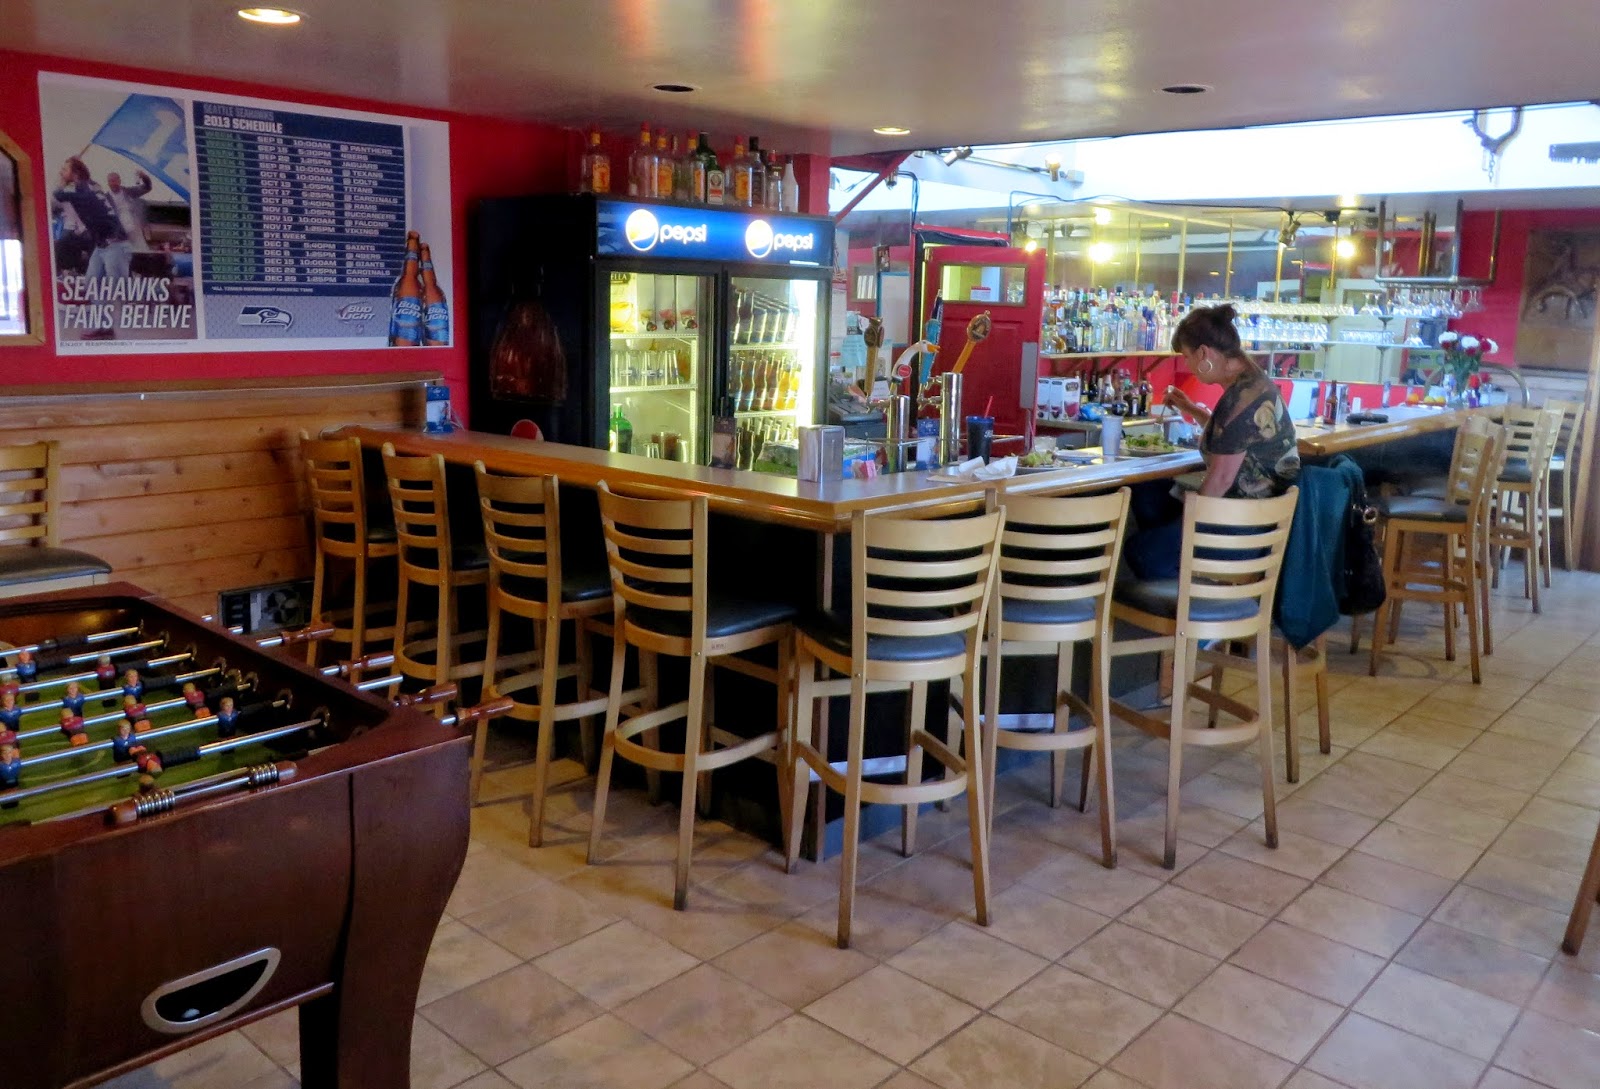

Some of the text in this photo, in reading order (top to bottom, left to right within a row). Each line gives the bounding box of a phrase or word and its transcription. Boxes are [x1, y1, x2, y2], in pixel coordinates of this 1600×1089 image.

[203, 114, 283, 134] 2013 SCHEDULE
[350, 146, 393, 155] PANTHERS
[352, 170, 383, 179] TEXANS
[353, 178, 378, 187] COLTS
[343, 186, 373, 194] TITANS
[354, 195, 398, 204] CARDINALS
[354, 203, 377, 211] RAMS
[354, 220, 389, 228] FALCONS
[263, 231, 280, 239] BYE
[282, 232, 307, 240] WEEK
[345, 228, 380, 236] VIKINGS
[659, 222, 708, 245] pepsi
[773, 231, 815, 252] pepsi
[355, 261, 385, 269] GIANTS
[62, 276, 171, 302] SEAHAWKS
[347, 305, 373, 313] BUD
[398, 300, 420, 312] BUD
[394, 308, 422, 318] LIGHT
[427, 307, 447, 315] BUD
[63, 304, 192, 329] FANS BELIEVE
[340, 312, 376, 320] LIGHT
[424, 312, 449, 322] LIGHT
